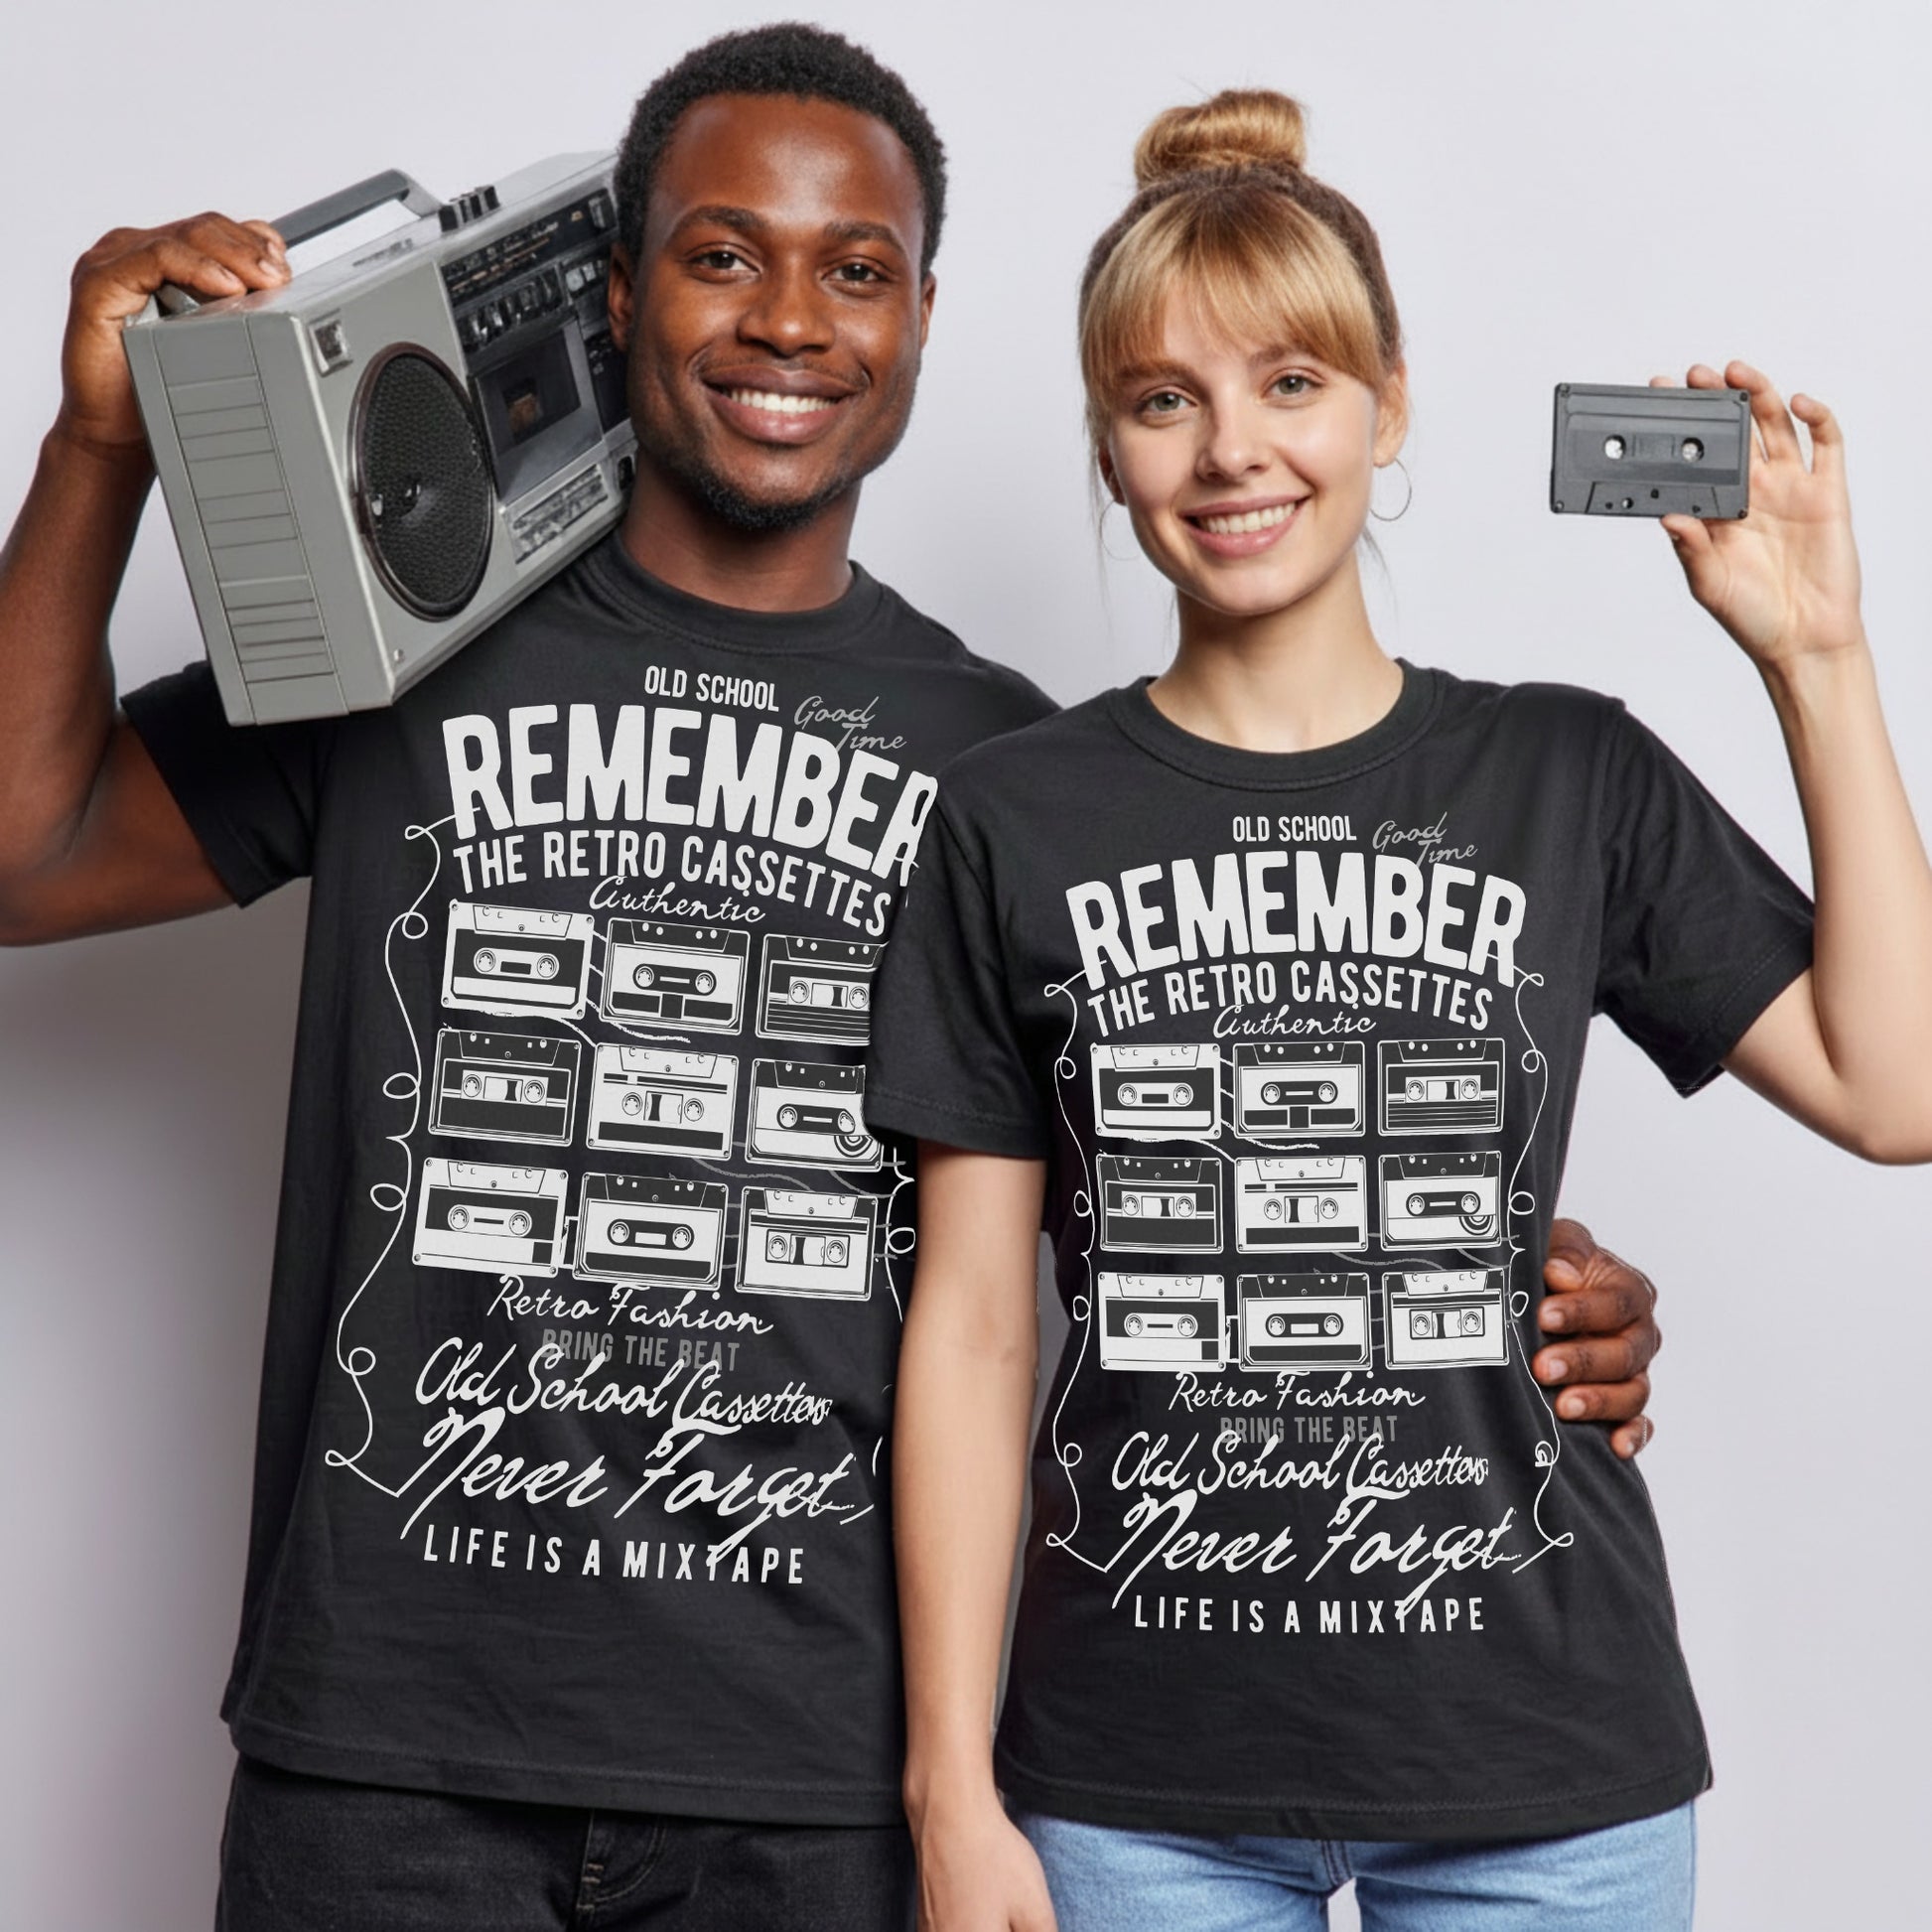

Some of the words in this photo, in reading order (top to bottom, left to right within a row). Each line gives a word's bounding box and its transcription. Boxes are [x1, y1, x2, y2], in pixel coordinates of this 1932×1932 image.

[644, 665, 688, 697] OLD
[695, 672, 780, 712] SCHOOL
[793, 696, 880, 727] Good
[834, 721, 908, 753] Time
[1232, 815, 1270, 843] OLD
[1278, 815, 1357, 843] SCHOOL
[1372, 811, 1448, 853] Good
[1415, 839, 1479, 869] Time
[453, 834, 527, 894] THE
[543, 829, 666, 880] RETRO
[681, 837, 892, 937] CASSETTES
[589, 875, 767, 923] Authentic
[1065, 850, 1527, 991] REMEMBER
[1087, 979, 1156, 1038] THE
[1165, 961, 1278, 1016] RETRO
[1291, 960, 1493, 1032] CASSETTES
[1212, 1003, 1377, 1038] Authentic
[486, 1273, 600, 1321] Retro
[608, 1282, 774, 1335] Fashion
[541, 1328, 614, 1364] BRING
[624, 1334, 668, 1367] THE
[678, 1338, 741, 1372] BEAT
[415, 1336, 518, 1407] Old
[506, 1342, 685, 1415] School
[1168, 1371, 1268, 1413] Retro
[1275, 1371, 1427, 1411] Fashion
[1220, 1416, 1285, 1444] BRING
[1294, 1416, 1334, 1444] THE
[1343, 1415, 1399, 1444] BEAT
[1111, 1431, 1199, 1491] Old
[1196, 1430, 1351, 1495] School
[400, 1407, 609, 1540] Never
[615, 1430, 859, 1567] Forget
[423, 1524, 508, 1569] LIFE
[525, 1534, 564, 1574] IS
[582, 1539, 601, 1577] A
[621, 1540, 804, 1585] MIXTAPE
[1111, 1489, 1298, 1609] Never
[1306, 1495, 1523, 1620] Forget
[1134, 1594, 1214, 1631] LIFE
[1232, 1599, 1264, 1633] IS
[1284, 1600, 1302, 1634] A
[1318, 1596, 1485, 1634] MIXTAPE
